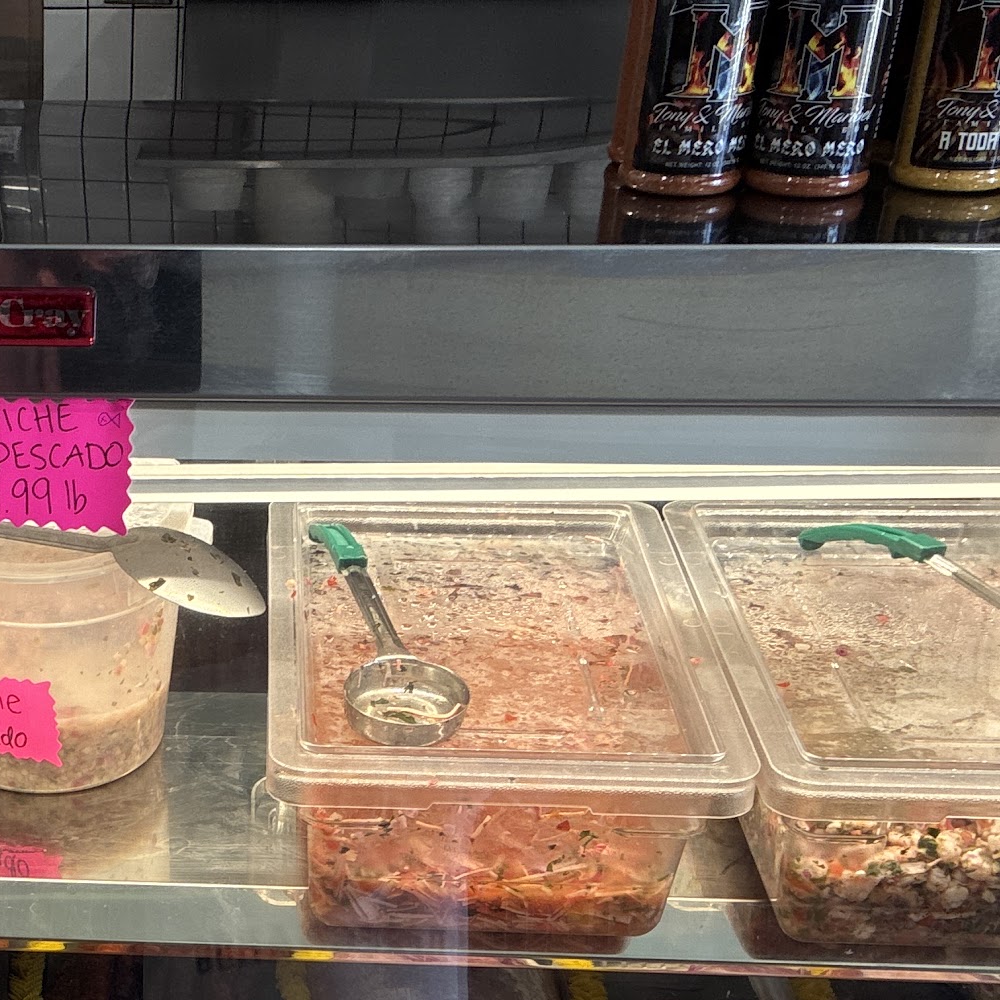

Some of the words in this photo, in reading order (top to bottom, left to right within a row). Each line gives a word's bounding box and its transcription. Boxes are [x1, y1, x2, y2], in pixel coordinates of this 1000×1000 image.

[652, 102, 694, 129] Tony
[692, 104, 715, 124] &
[783, 104, 802, 124] &
[936, 98, 981, 124] Tony
[979, 99, 999, 120] &
[943, 119, 1000, 128] FAMI
[652, 137, 673, 156] EL
[677, 139, 725, 157] MERO
[727, 134, 748, 153] ME
[769, 136, 817, 157] MERO
[821, 138, 865, 157] MERO
[938, 130, 953, 151] A
[957, 131, 999, 152] TODA
[64, 479, 88, 515] lb
